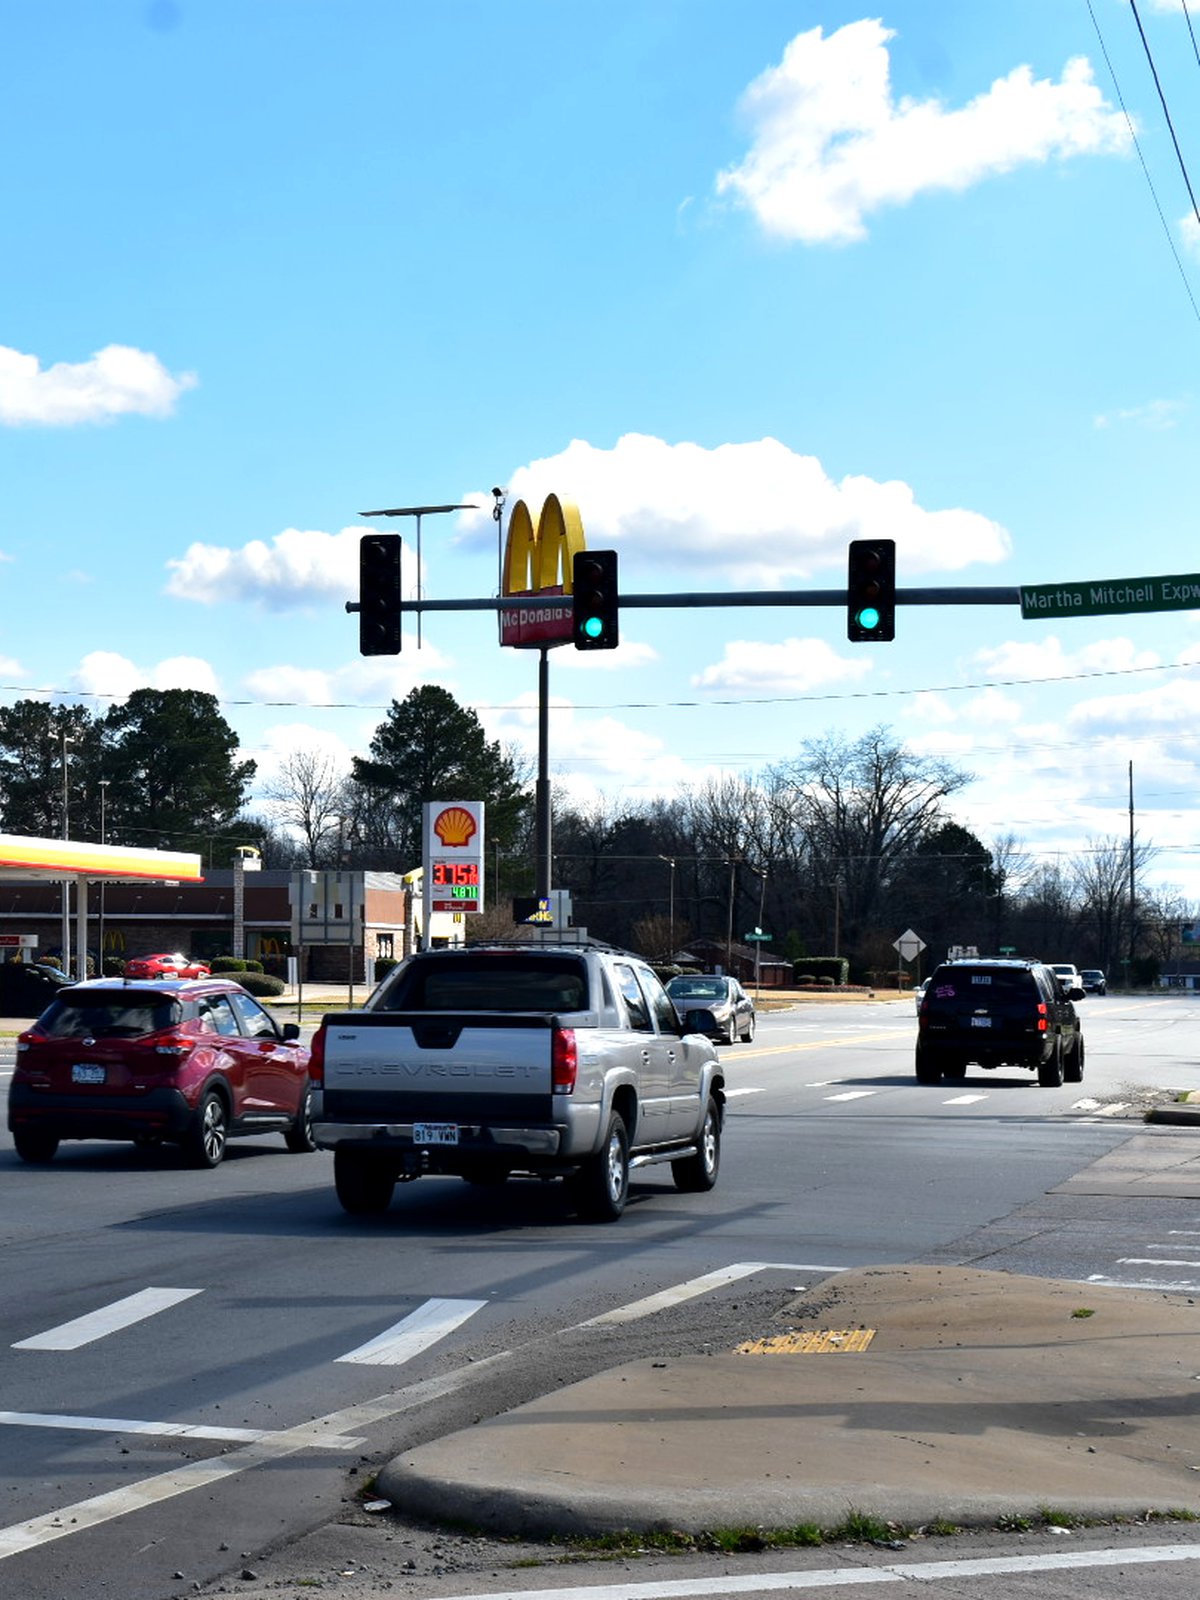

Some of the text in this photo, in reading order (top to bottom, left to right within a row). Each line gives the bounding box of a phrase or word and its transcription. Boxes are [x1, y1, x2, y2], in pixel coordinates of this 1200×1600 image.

[1024, 590, 1082, 610] Martha
[1090, 584, 1153, 605] Mitchell
[502, 607, 573, 627] McDonalds
[335, 1062, 543, 1079] CHEVROLET
[414, 1129, 433, 1141] 819
